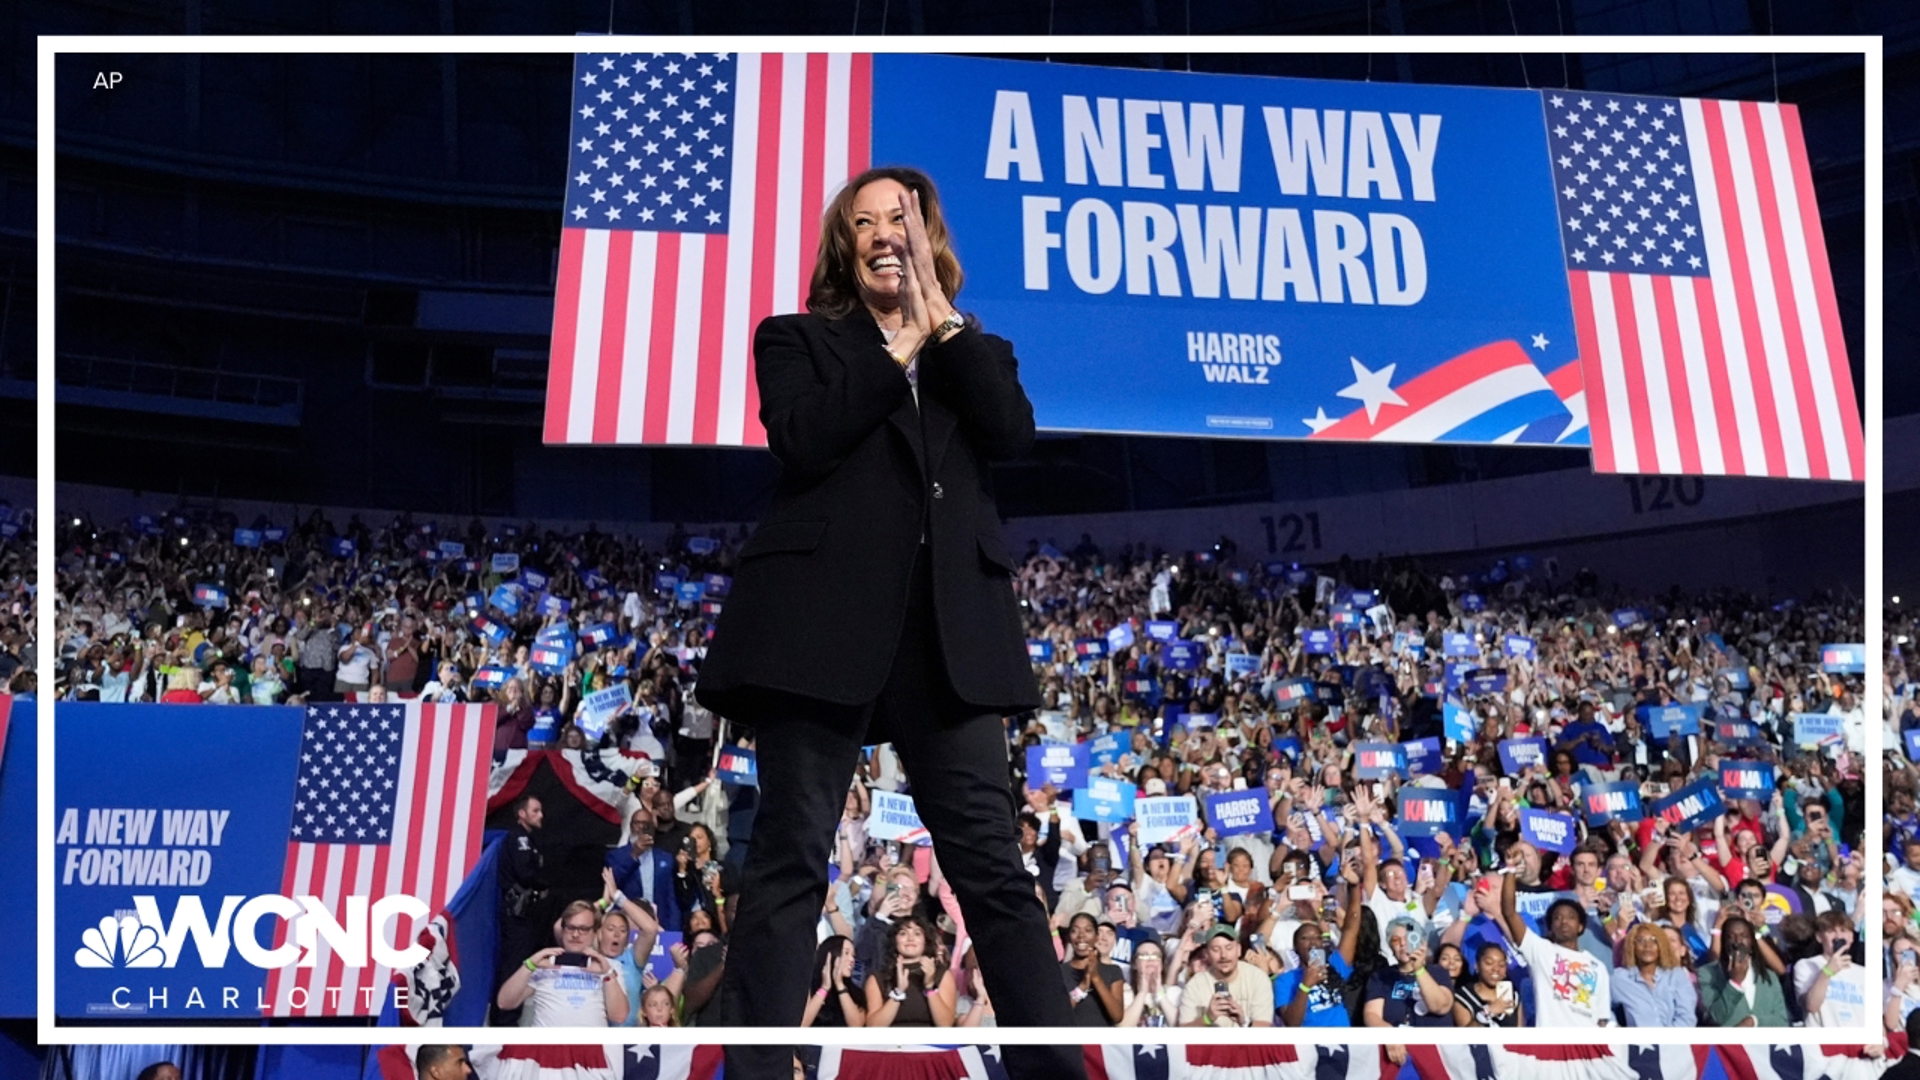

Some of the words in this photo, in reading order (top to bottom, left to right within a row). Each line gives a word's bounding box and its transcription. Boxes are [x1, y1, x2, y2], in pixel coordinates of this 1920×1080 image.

[984, 90, 1044, 182] A
[1062, 94, 1245, 192] NEW
[1263, 105, 1443, 202] WAY
[1022, 195, 1428, 307] FORWARD
[1187, 331, 1281, 366] HARRIS
[1202, 363, 1270, 385] WALZ
[1622, 474, 1705, 515] 120
[1260, 512, 1323, 554] 121
[1361, 750, 1405, 769] KAMALA
[1723, 769, 1774, 790] KAMALA
[1151, 803, 1172, 814] NEW
[1174, 802, 1190, 813] WAY
[1215, 797, 1261, 821] HARRIS
[1404, 799, 1456, 822] KAMALA
[1588, 791, 1638, 814] KAMALA
[1661, 788, 1717, 824] KAMALA
[57, 808, 79, 845] A
[85, 808, 157, 846] NEW
[162, 809, 231, 847] WAY
[1224, 814, 1257, 829] WALZ
[1529, 815, 1568, 838] HARRIS
[1537, 830, 1564, 846] WALZ
[62, 847, 213, 887] FORWARD
